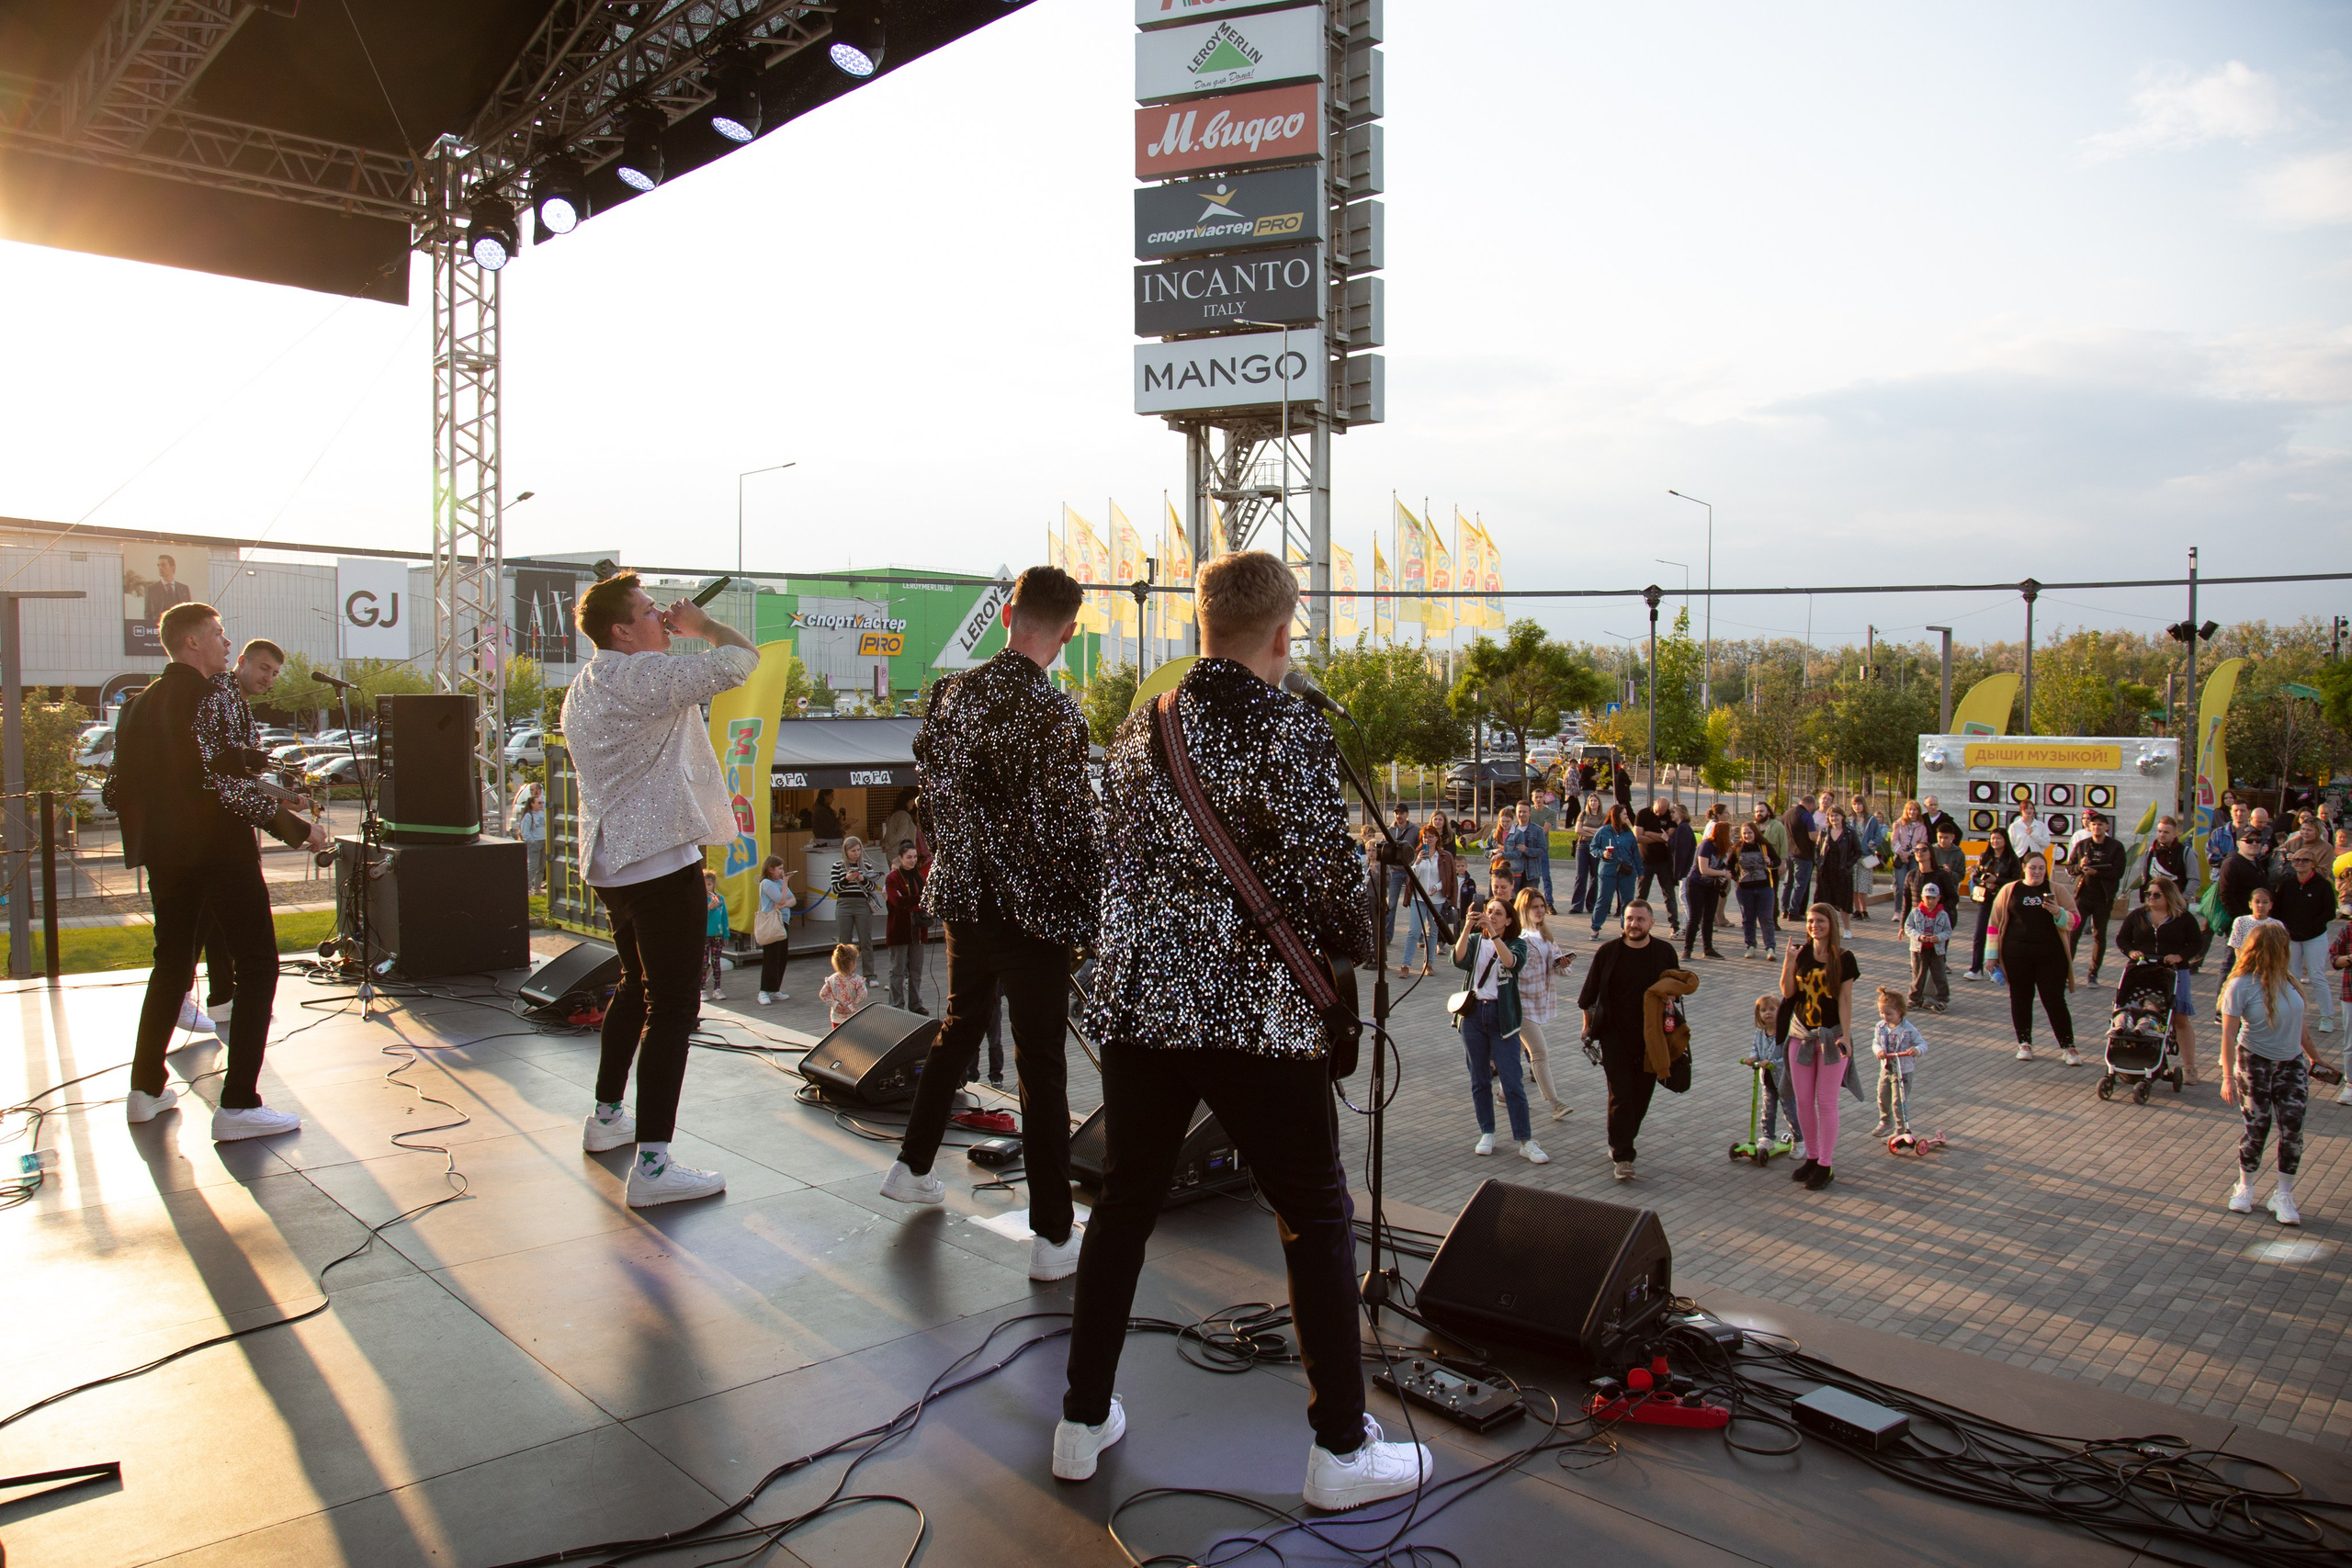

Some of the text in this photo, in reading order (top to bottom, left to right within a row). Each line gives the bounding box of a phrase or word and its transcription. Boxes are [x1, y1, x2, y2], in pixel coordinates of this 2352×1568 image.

[1186, 21, 1263, 73] LEROY MERLIN
[1258, 216, 1299, 232] PRO
[1142, 258, 1310, 303] INCANTO
[1204, 301, 1247, 317] ITALY
[1145, 351, 1307, 392] MANGO
[346, 591, 399, 628] GJ
[960, 589, 1001, 652] LEROY
[864, 637, 900, 651] PRO
[1975, 749, 2108, 762] ДЫШИ МУЗЫКОЙ!
